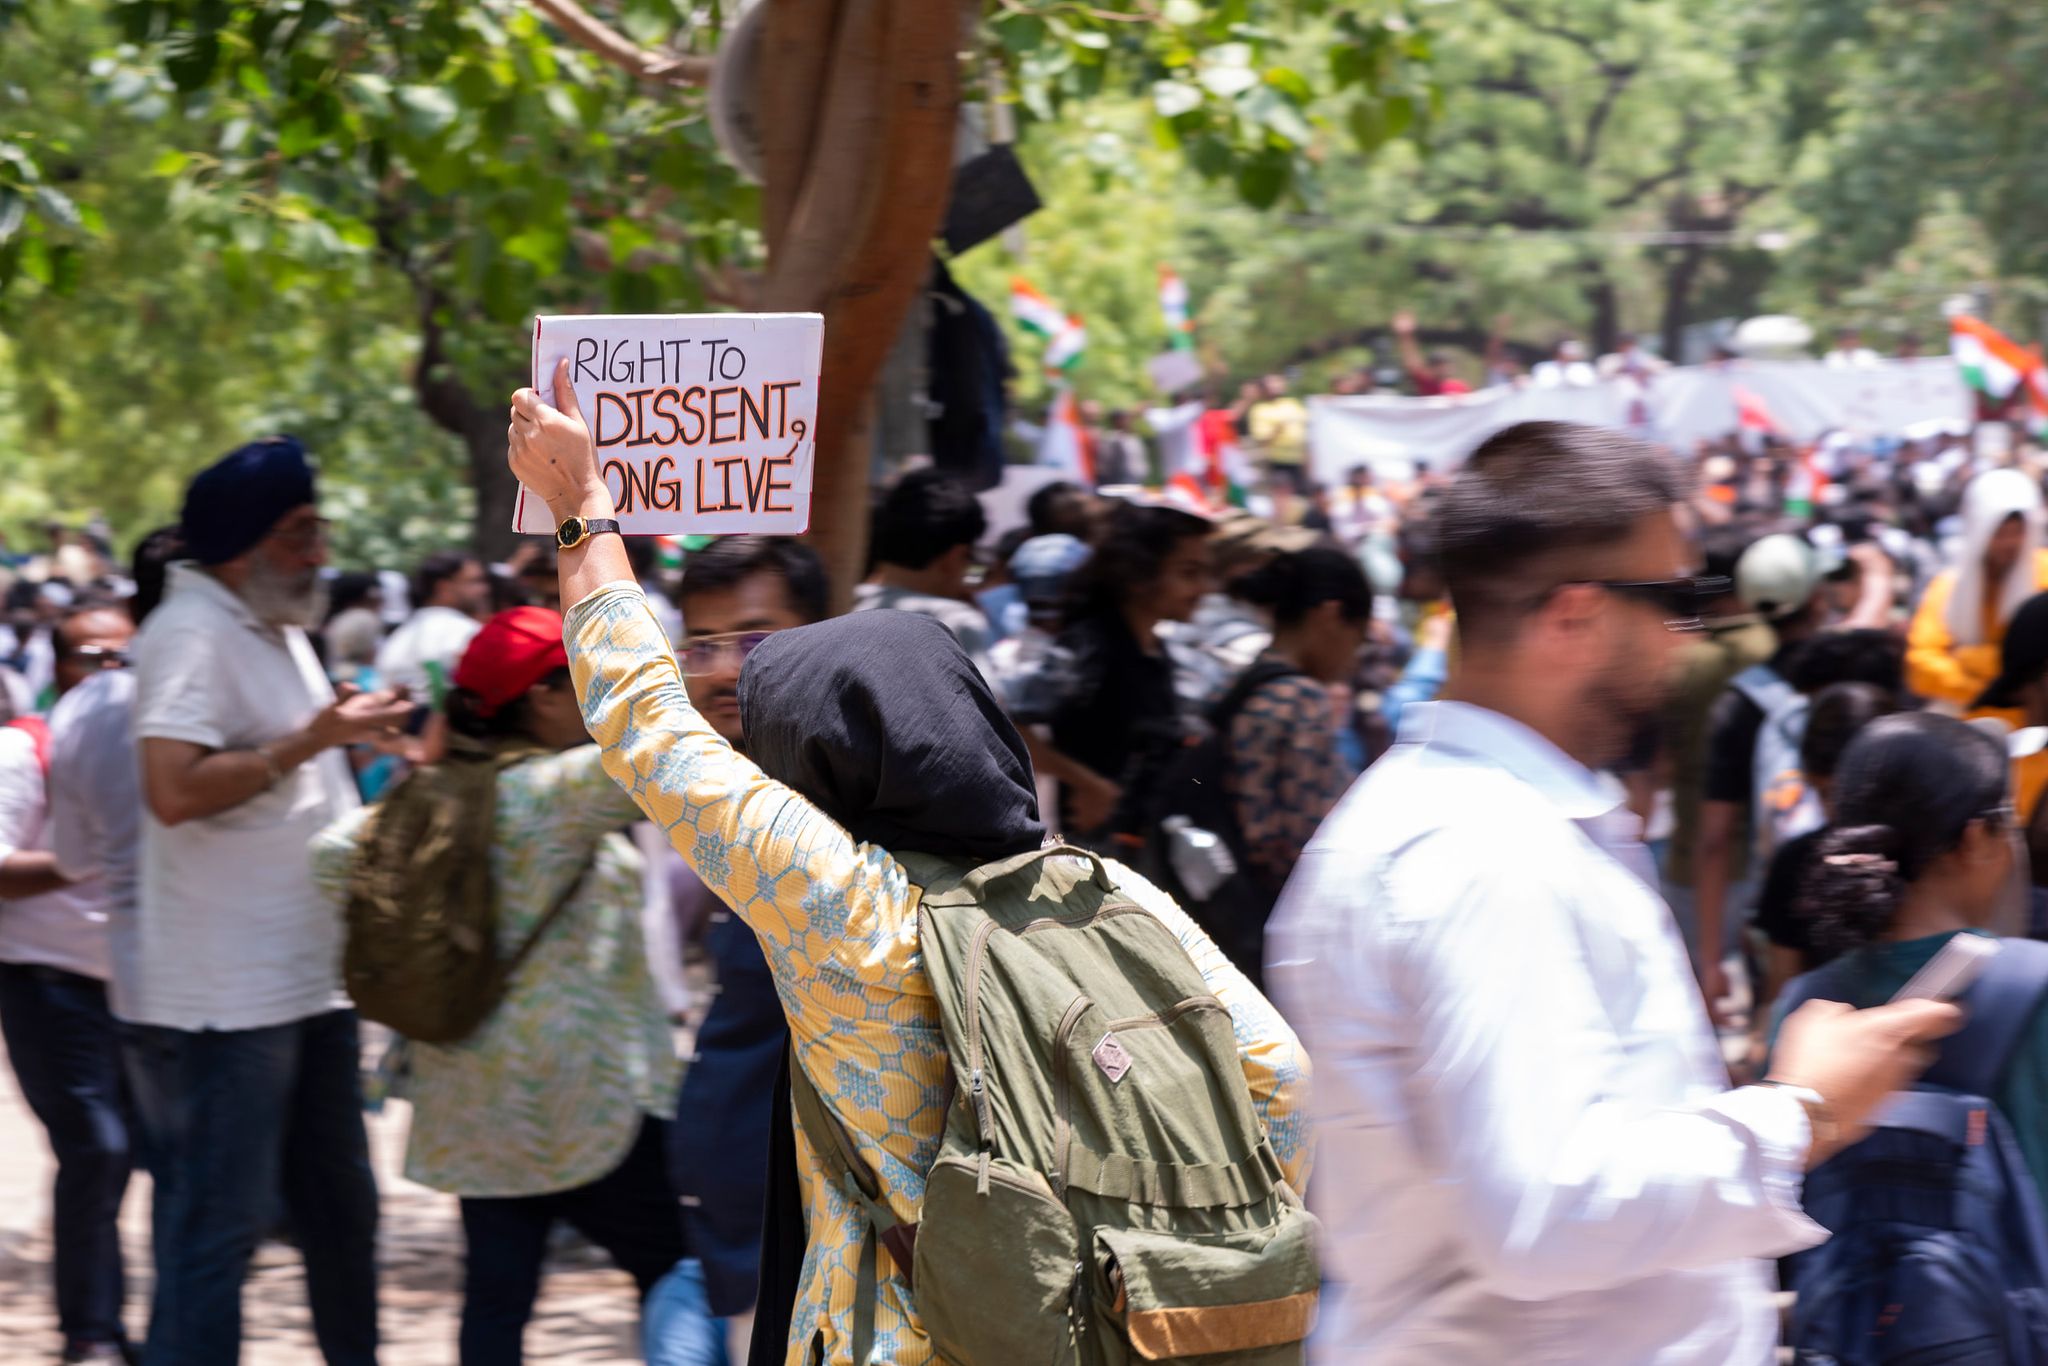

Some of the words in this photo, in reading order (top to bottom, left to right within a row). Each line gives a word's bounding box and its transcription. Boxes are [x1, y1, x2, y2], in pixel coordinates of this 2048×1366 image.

[574, 337, 691, 384] RIGHT
[701, 339, 746, 382] TO
[594, 380, 807, 458] DISSENT,
[602, 455, 682, 514] ONG
[695, 456, 794, 514] LIVE
